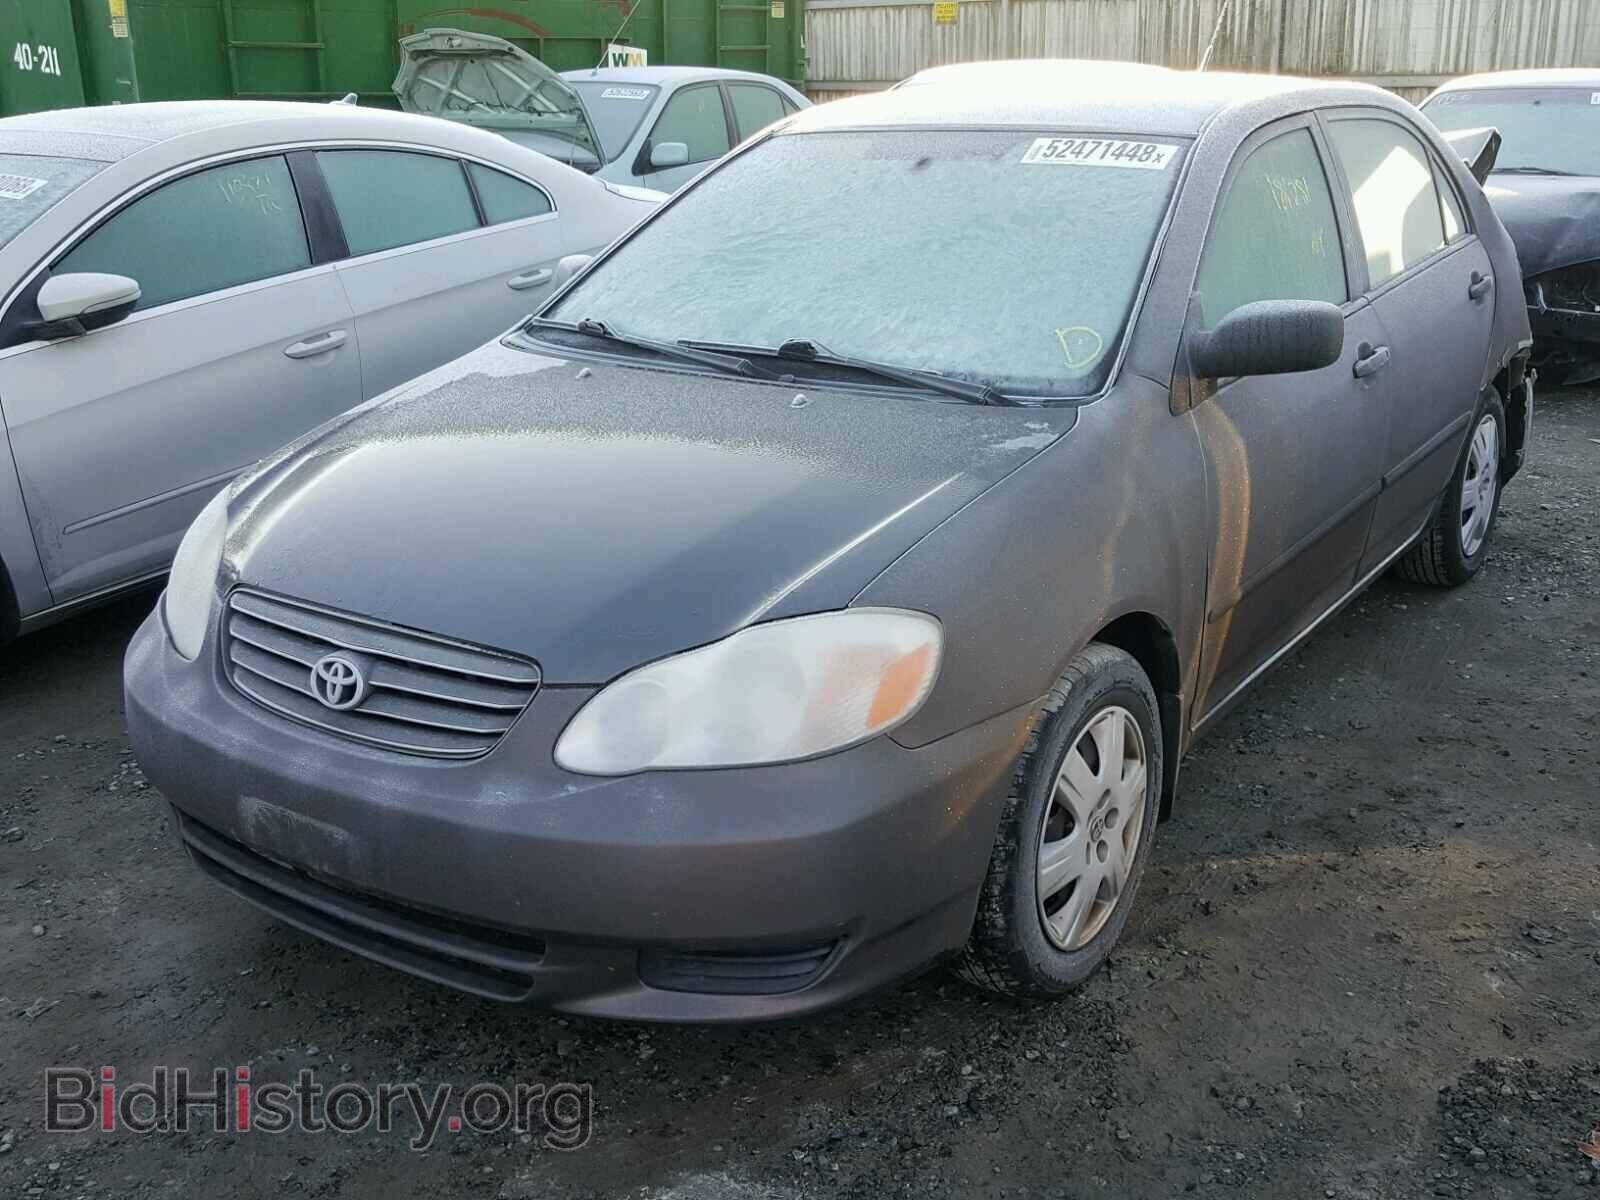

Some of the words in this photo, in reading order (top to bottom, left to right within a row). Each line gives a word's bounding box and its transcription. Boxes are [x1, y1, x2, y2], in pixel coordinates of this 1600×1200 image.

[14, 42, 61, 76] 40-211
[612, 52, 644, 67] WM
[1055, 325, 1103, 368] D
